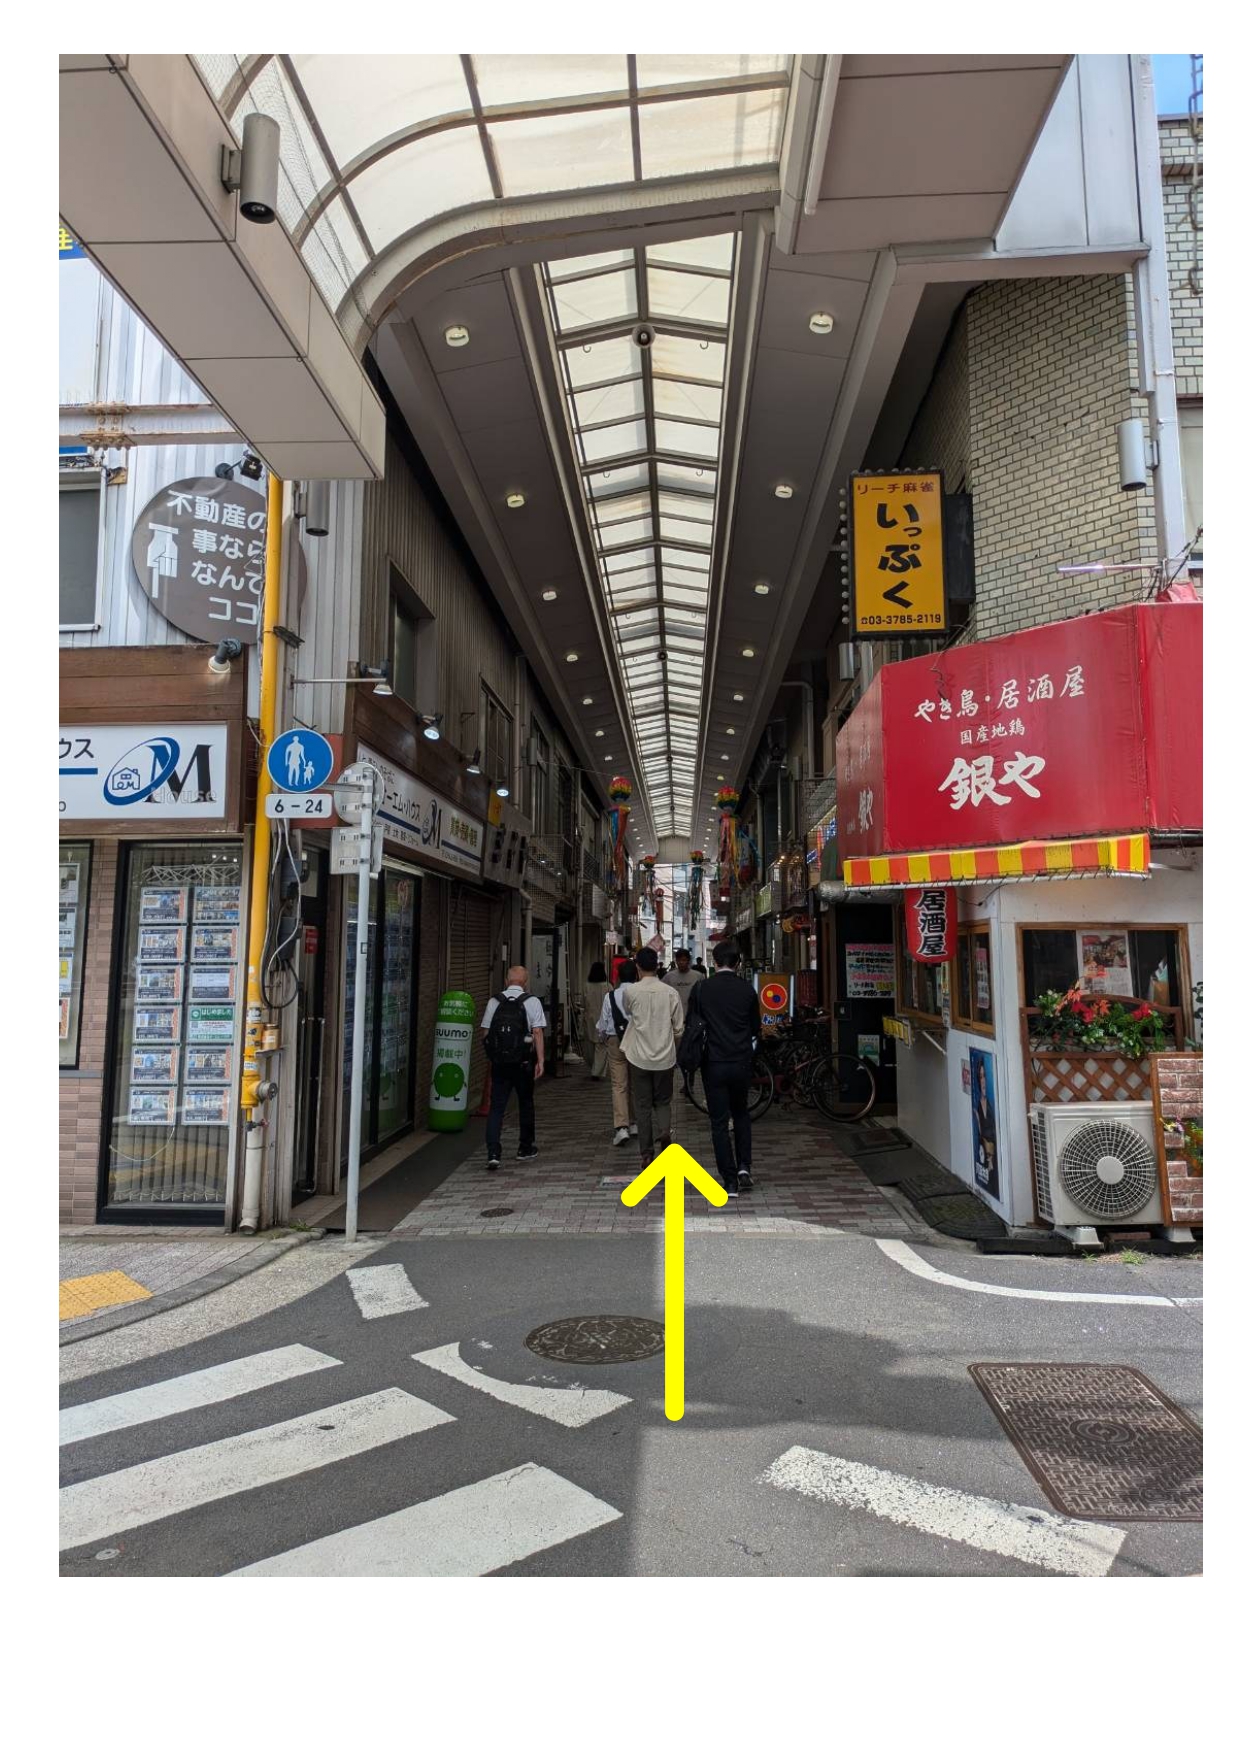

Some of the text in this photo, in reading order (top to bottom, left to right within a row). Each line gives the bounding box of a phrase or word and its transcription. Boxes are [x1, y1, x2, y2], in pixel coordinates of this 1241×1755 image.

[856, 482, 935, 495] リーチ麻雀
[167, 490, 266, 534] 不動産の
[191, 528, 266, 565] 事なら
[876, 502, 922, 609] いっぷく
[208, 596, 259, 625] ココ
[868, 613, 942, 626] 03-3785-2119
[913, 664, 1087, 723] やき鳥・居酒屋
[960, 718, 1026, 745] 国産地鶏
[938, 751, 1046, 811] 銀や
[916, 889, 947, 957] 居酒屋
